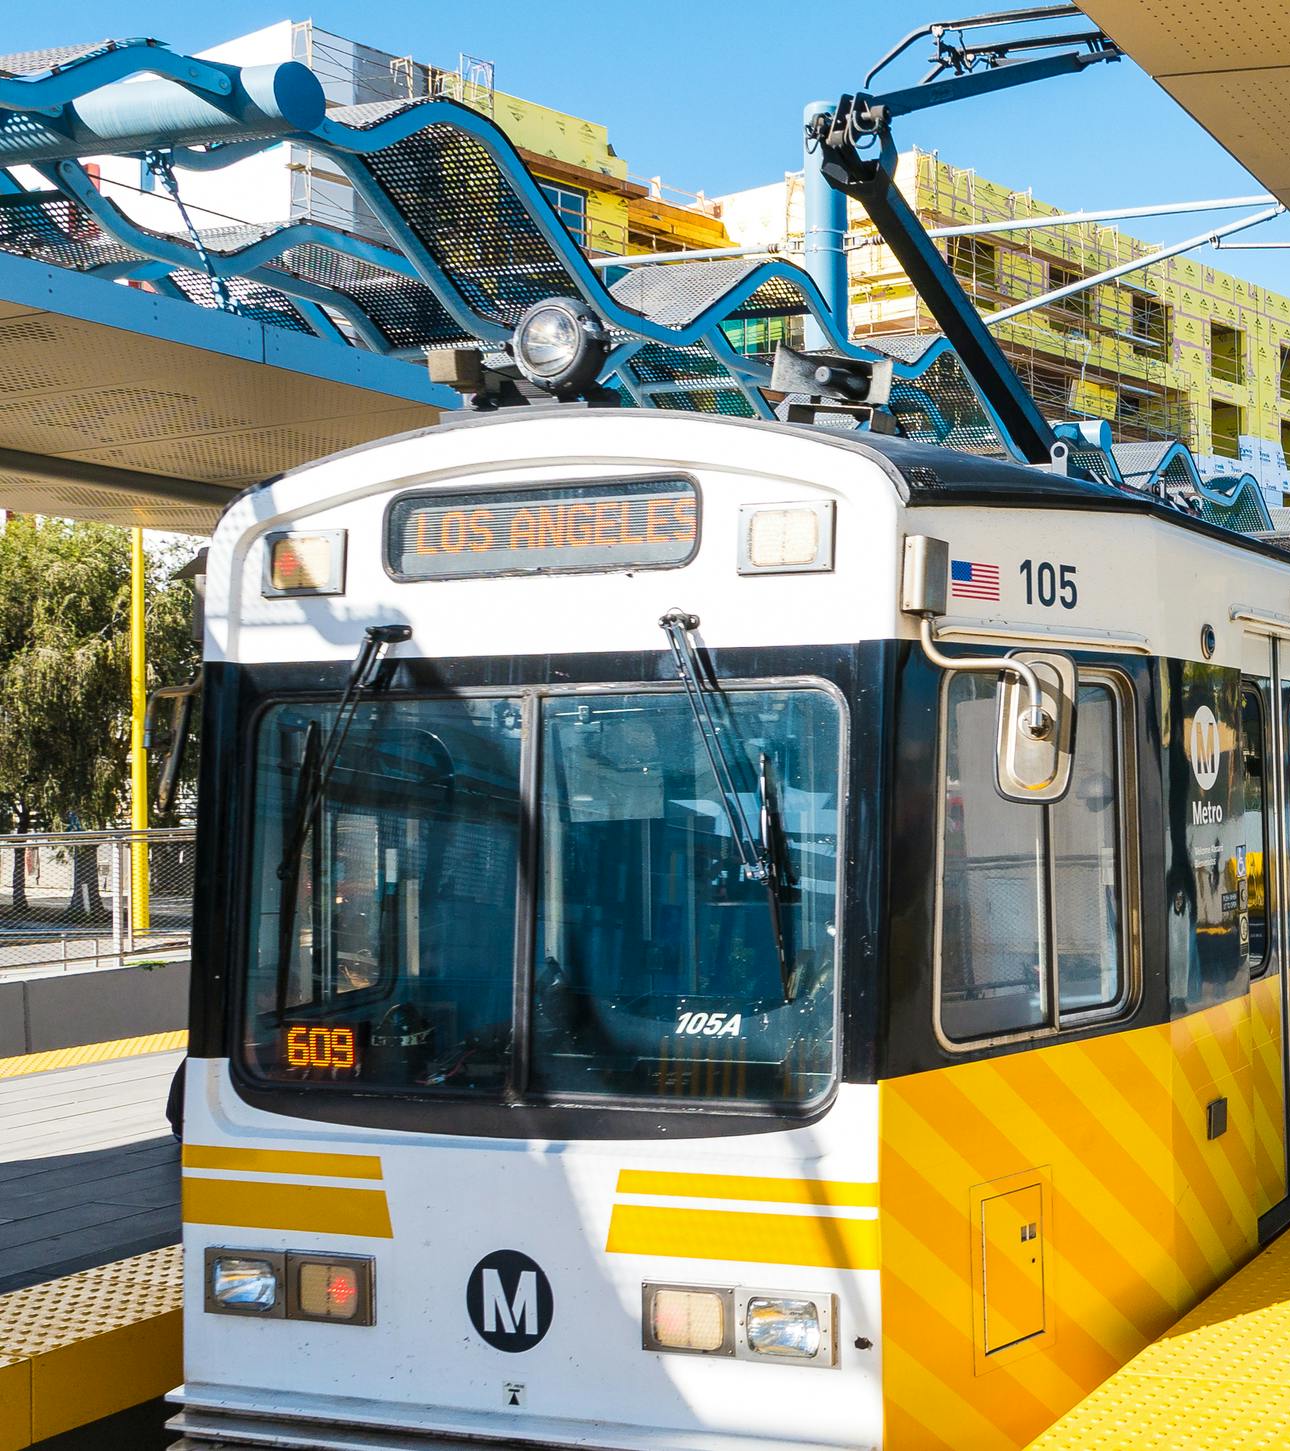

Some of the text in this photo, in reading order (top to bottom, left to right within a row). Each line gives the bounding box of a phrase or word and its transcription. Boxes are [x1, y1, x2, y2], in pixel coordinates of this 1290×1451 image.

[416, 496, 697, 556] LOS ANGELES
[1019, 559, 1078, 610] 105
[1196, 722, 1216, 774] M
[1192, 801, 1223, 825] Metro
[286, 1025, 355, 1070] 609
[675, 1011, 742, 1037] 105A
[482, 1267, 539, 1336] M
